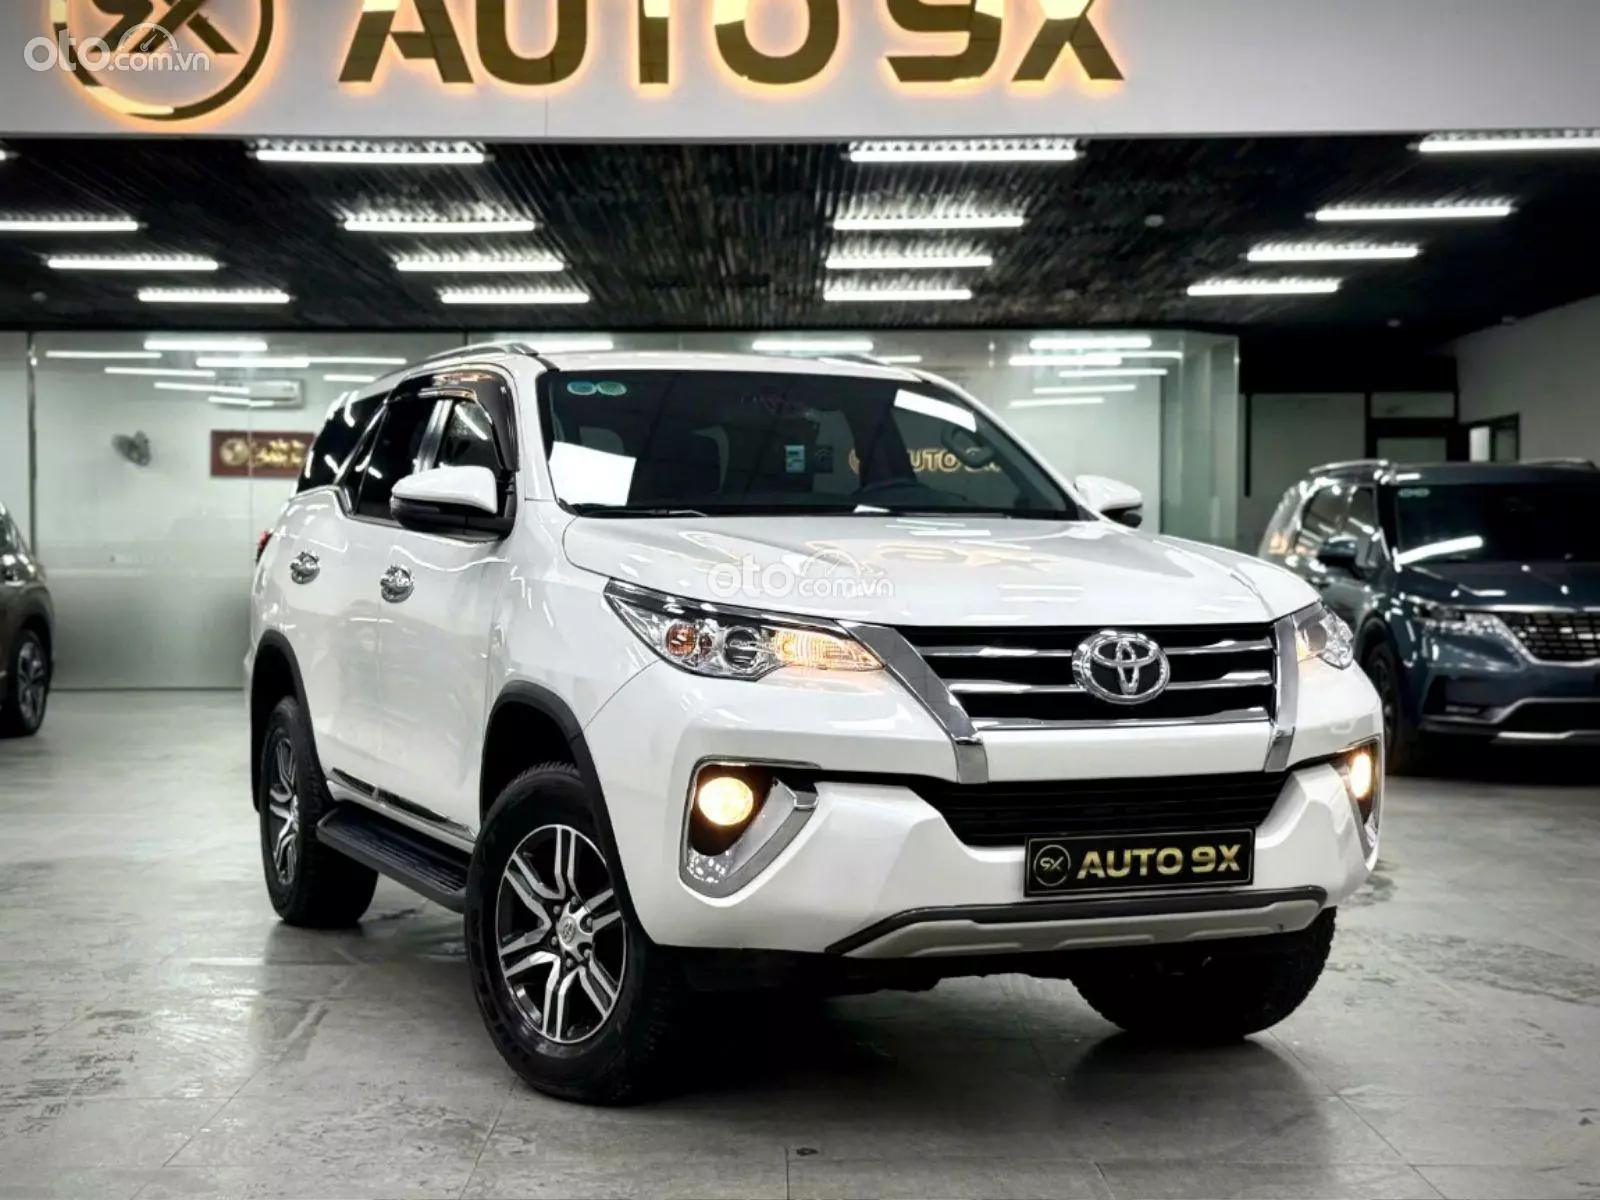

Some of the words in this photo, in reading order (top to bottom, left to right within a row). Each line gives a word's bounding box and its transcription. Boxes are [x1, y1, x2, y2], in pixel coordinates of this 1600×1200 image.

[338, 0, 840, 85] AUTO
[908, 448, 961, 473] UTO
[1039, 857, 1064, 872] 9X
[1076, 848, 1184, 879] AUTO
[1190, 844, 1241, 873] 9X
